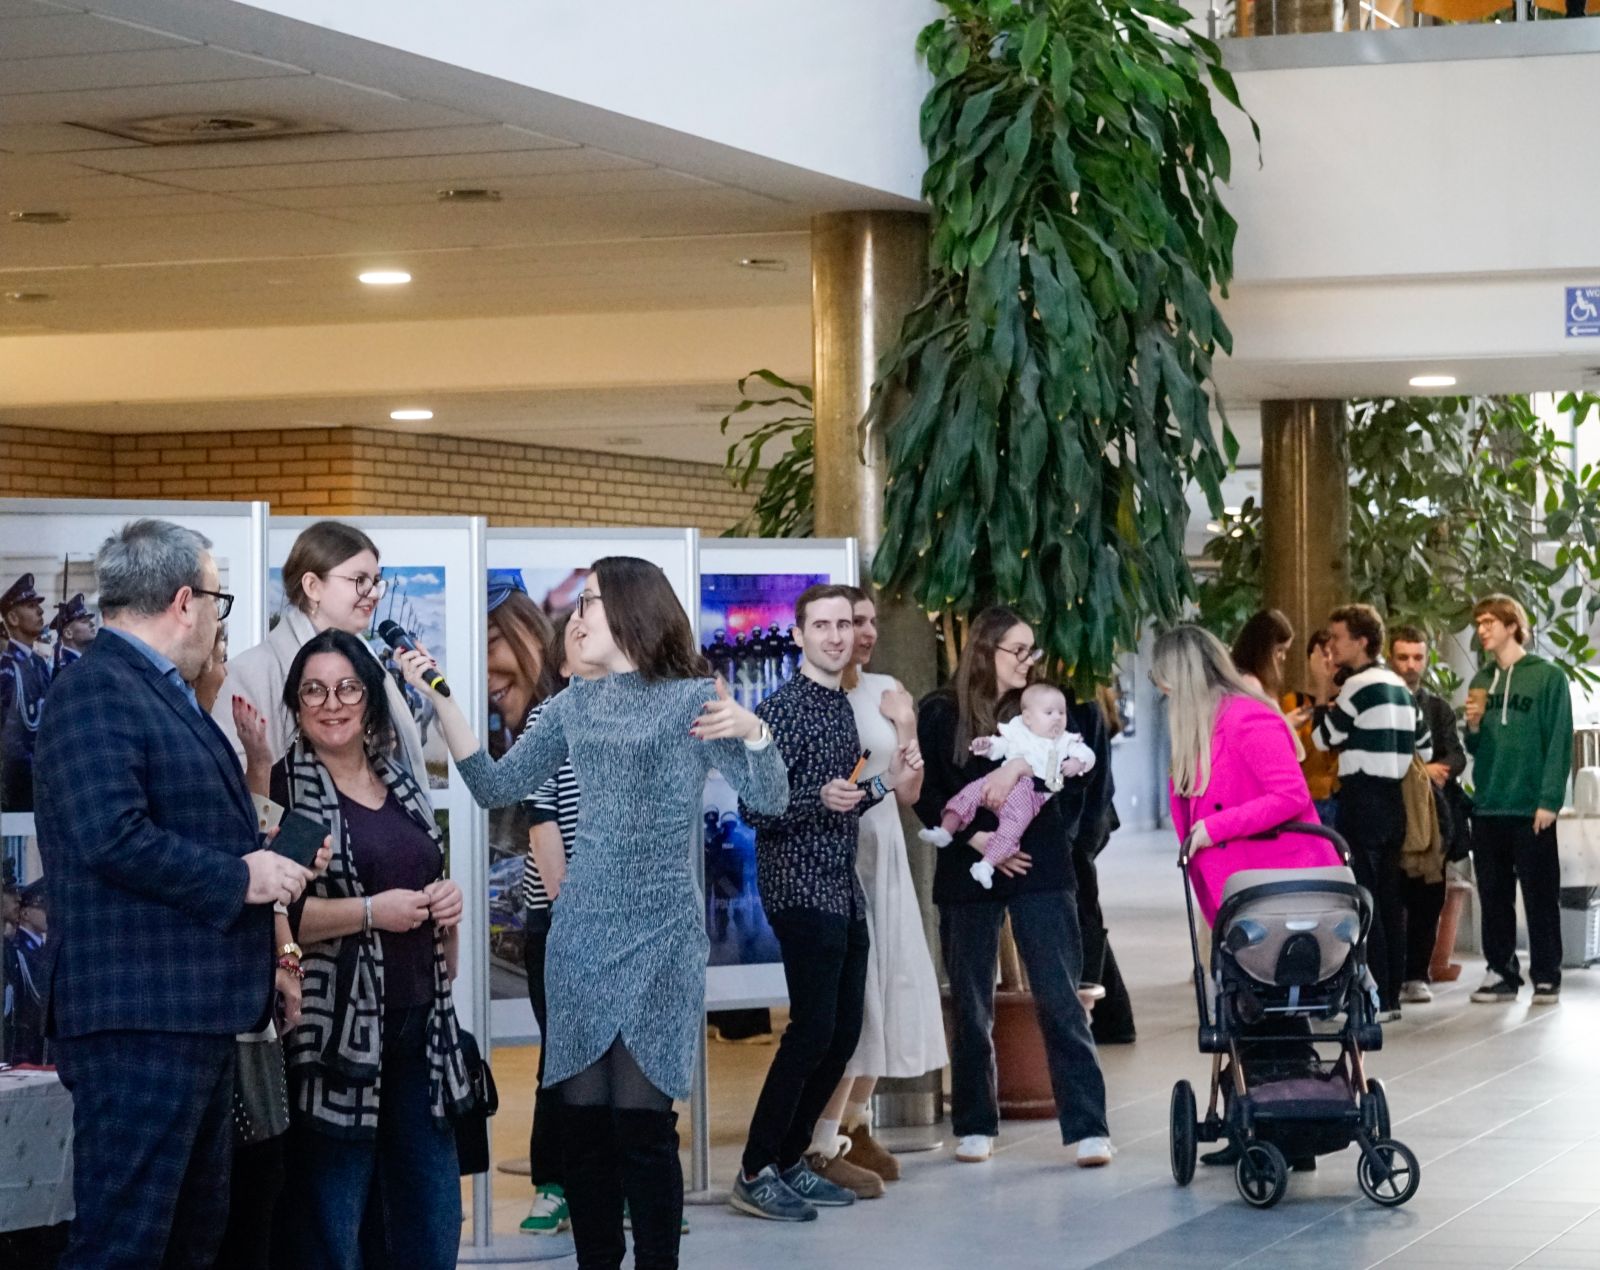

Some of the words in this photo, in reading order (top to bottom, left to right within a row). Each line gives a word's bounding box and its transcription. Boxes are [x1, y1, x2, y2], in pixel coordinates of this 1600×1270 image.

[1585, 289, 1600, 298] WC
[792, 1171, 819, 1194] N
[752, 1184, 777, 1206] N
